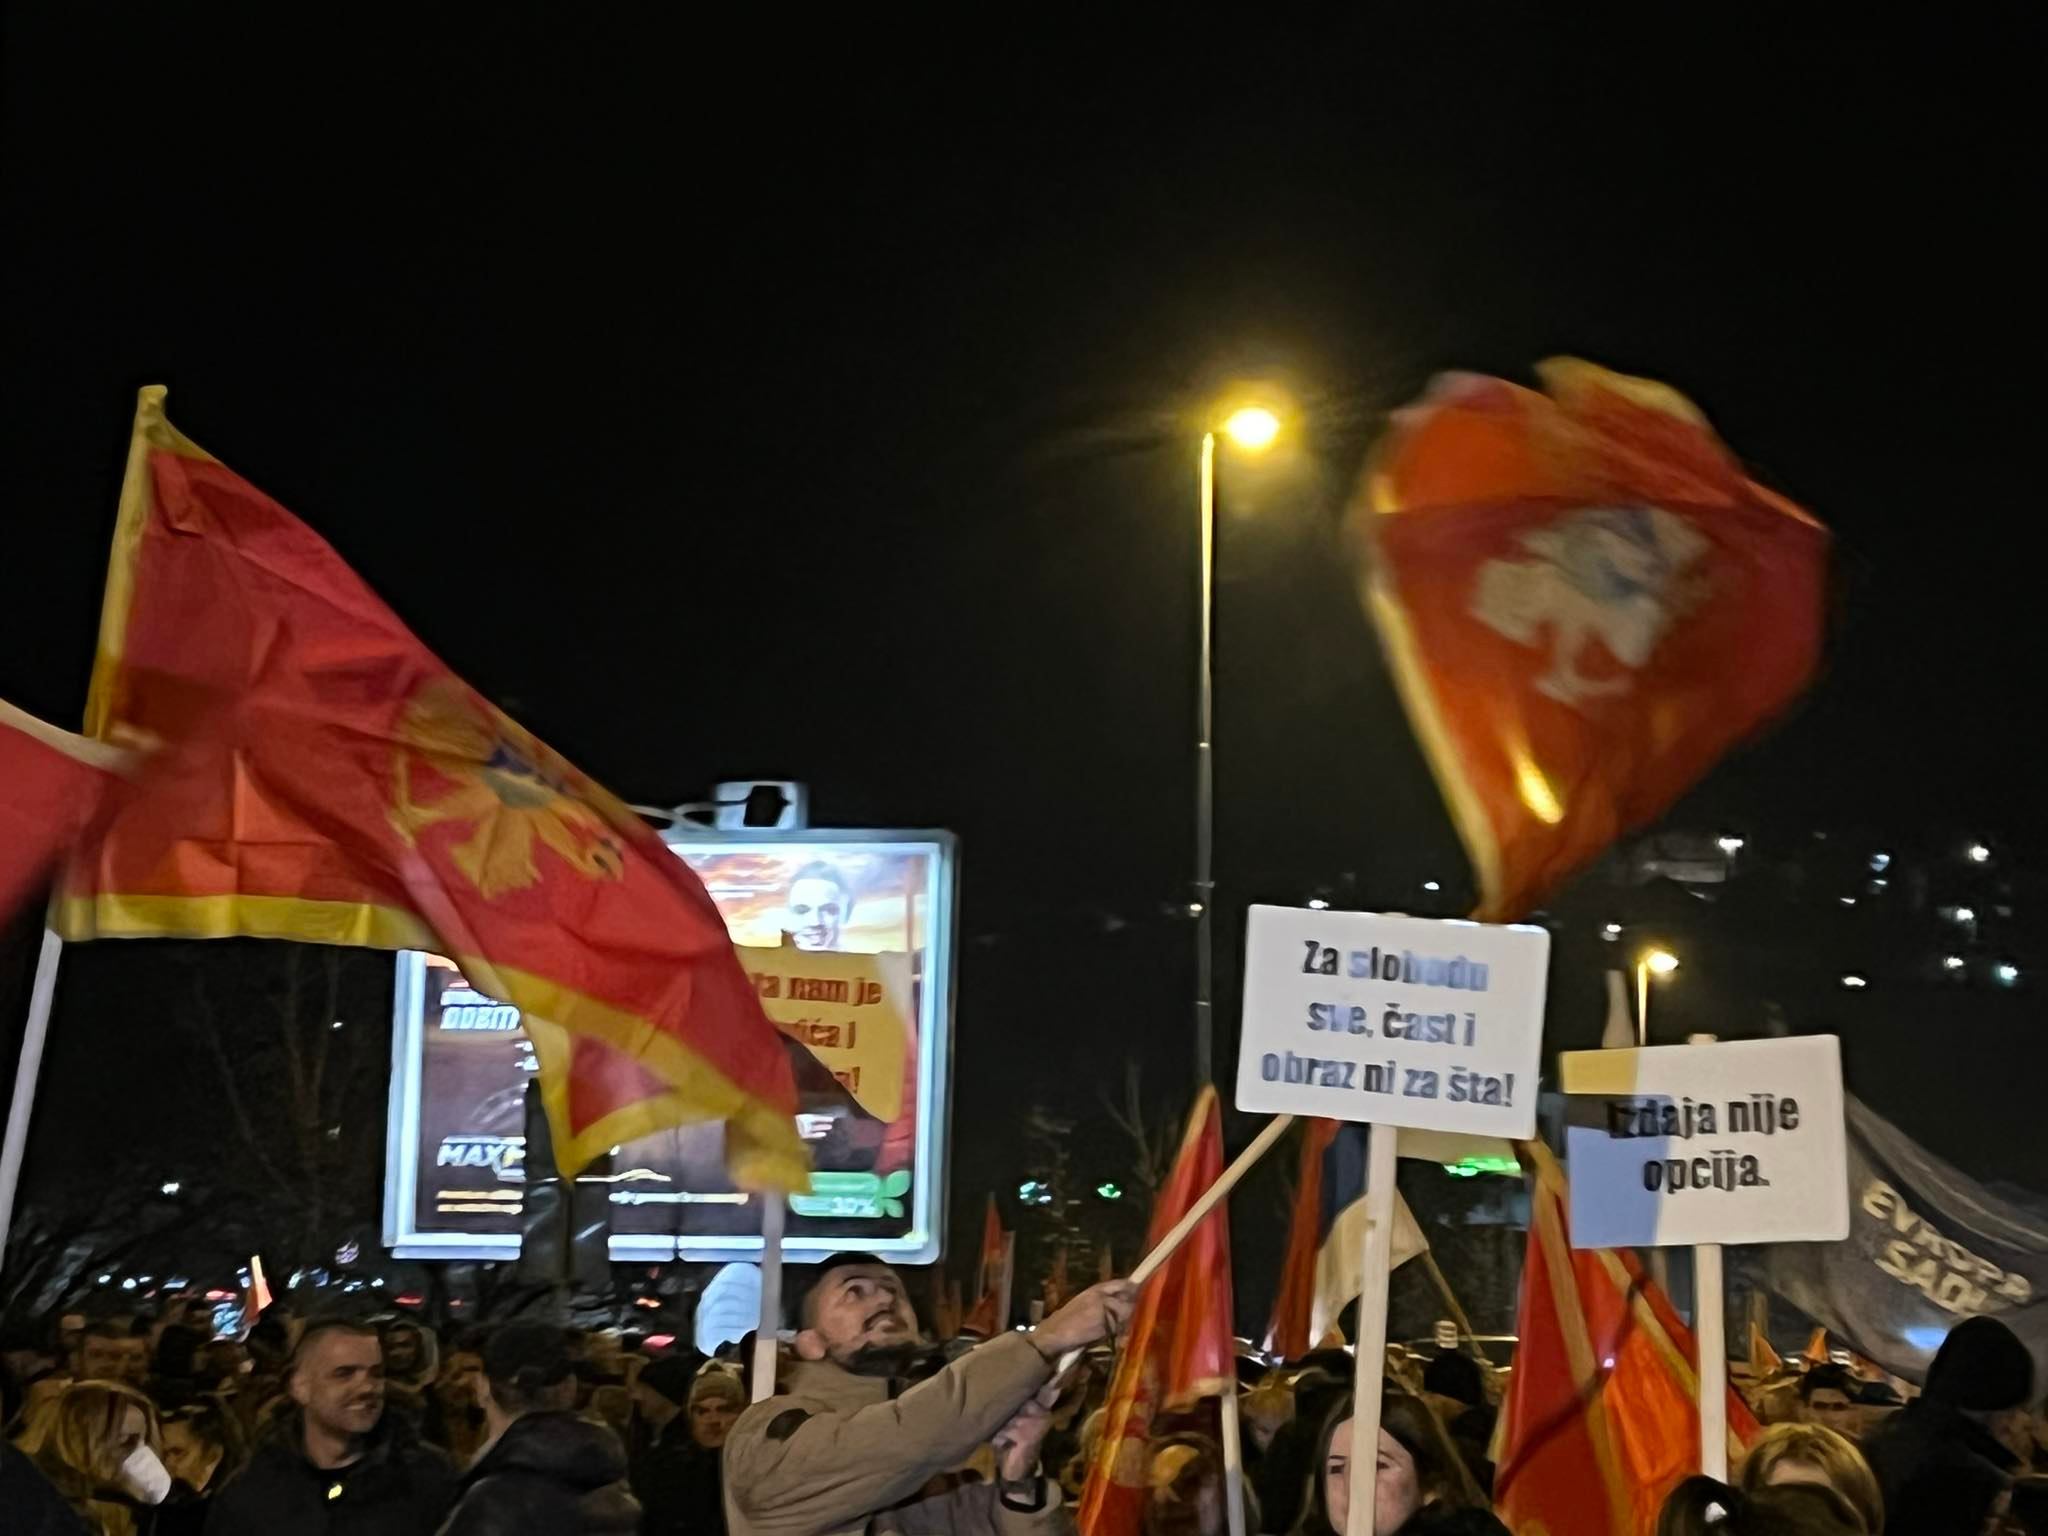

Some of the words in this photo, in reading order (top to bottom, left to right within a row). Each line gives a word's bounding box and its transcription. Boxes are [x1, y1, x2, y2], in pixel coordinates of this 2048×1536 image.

[1302, 939, 1339, 976] Za
[853, 977, 882, 1006] je
[1382, 1002, 1457, 1045] čast
[1463, 1012, 1477, 1047] i
[1261, 1050, 1357, 1090] obraz
[1363, 1060, 1397, 1094] ni
[1403, 1068, 1441, 1099] za
[1446, 1065, 1515, 1107] šta!
[1726, 1092, 1800, 1135] nije
[1643, 1148, 1771, 1194] opcija.
